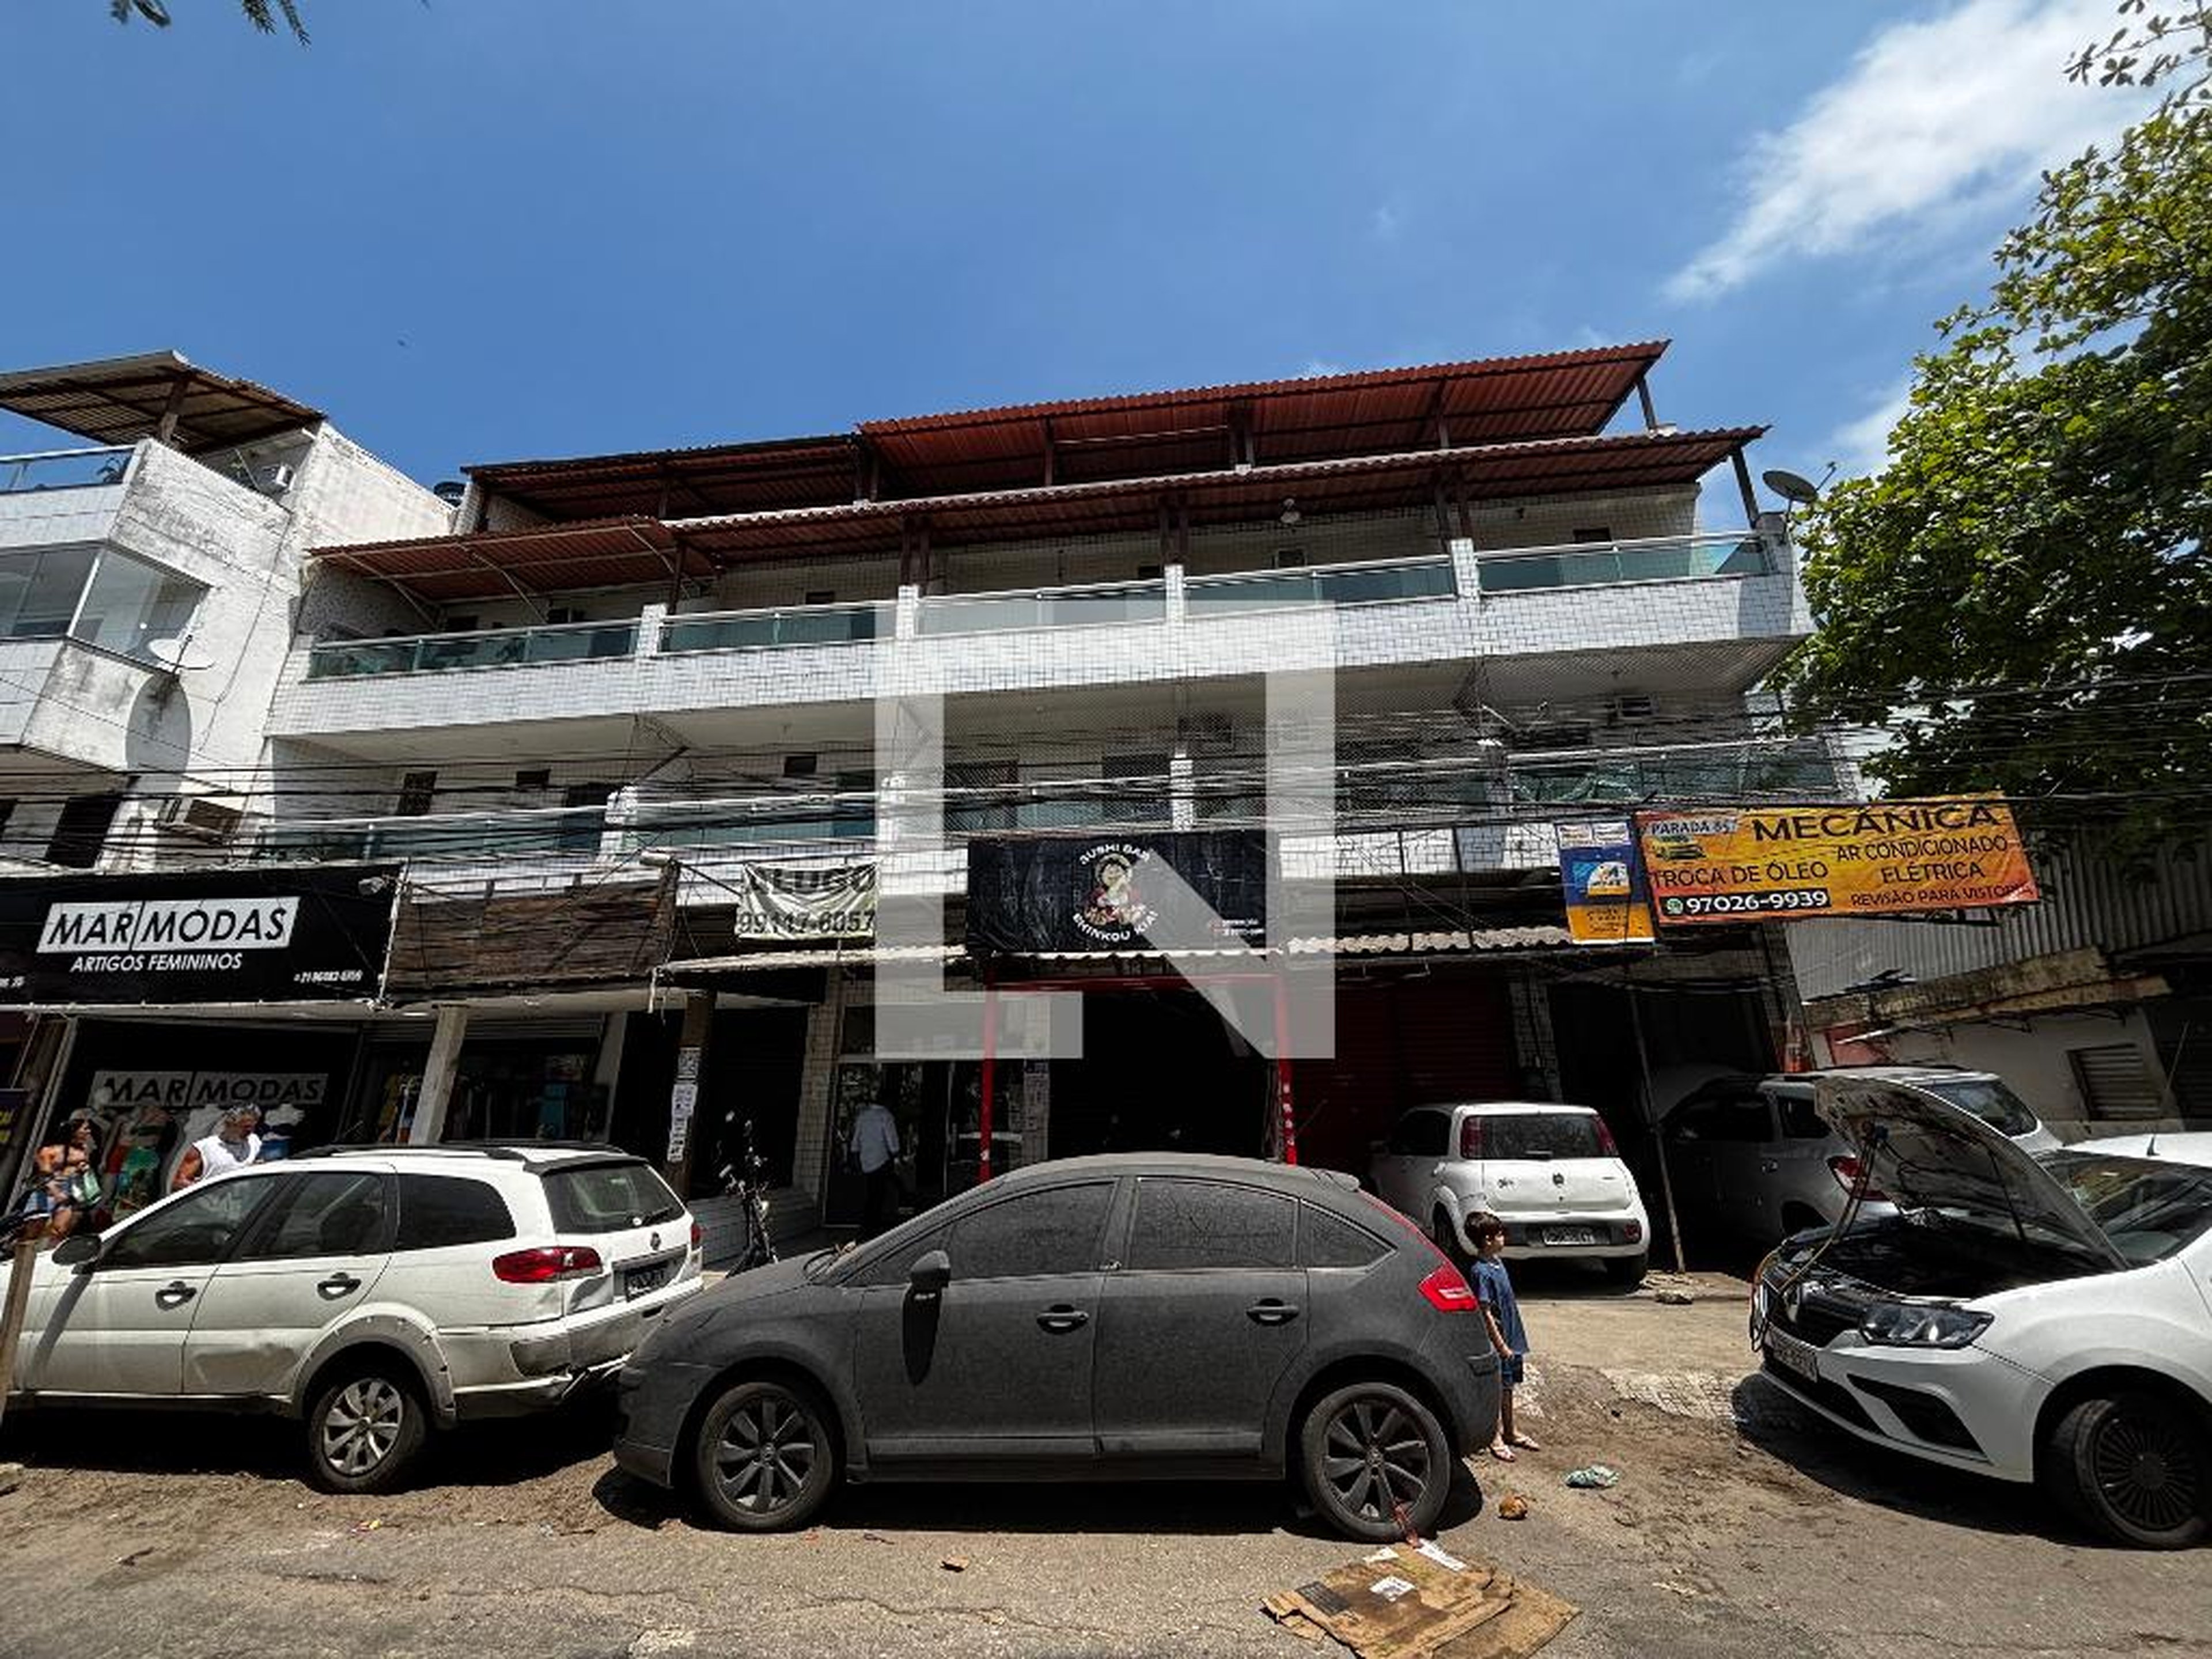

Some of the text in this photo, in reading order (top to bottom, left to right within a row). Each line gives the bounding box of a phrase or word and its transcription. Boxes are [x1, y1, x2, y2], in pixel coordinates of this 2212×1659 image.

[1752, 805, 2001, 841] MECÂNICA
[1837, 835, 2008, 862] AR CONDICIONADO
[1649, 867, 1726, 888] TROCA
[1731, 866, 1762, 884] DE
[1766, 859, 1828, 882] ÓLEO
[1881, 862, 1986, 884] ELÉTRICA
[1686, 890, 1828, 914] 97026-9939
[1851, 890, 1914, 907] REVISÃO
[1919, 888, 1959, 902] PARA
[47, 908, 287, 945] MAR MODAS
[70, 952, 243, 972] ARTIGOS FEMININOS
[104, 1077, 322, 1102] MAR MODAS
